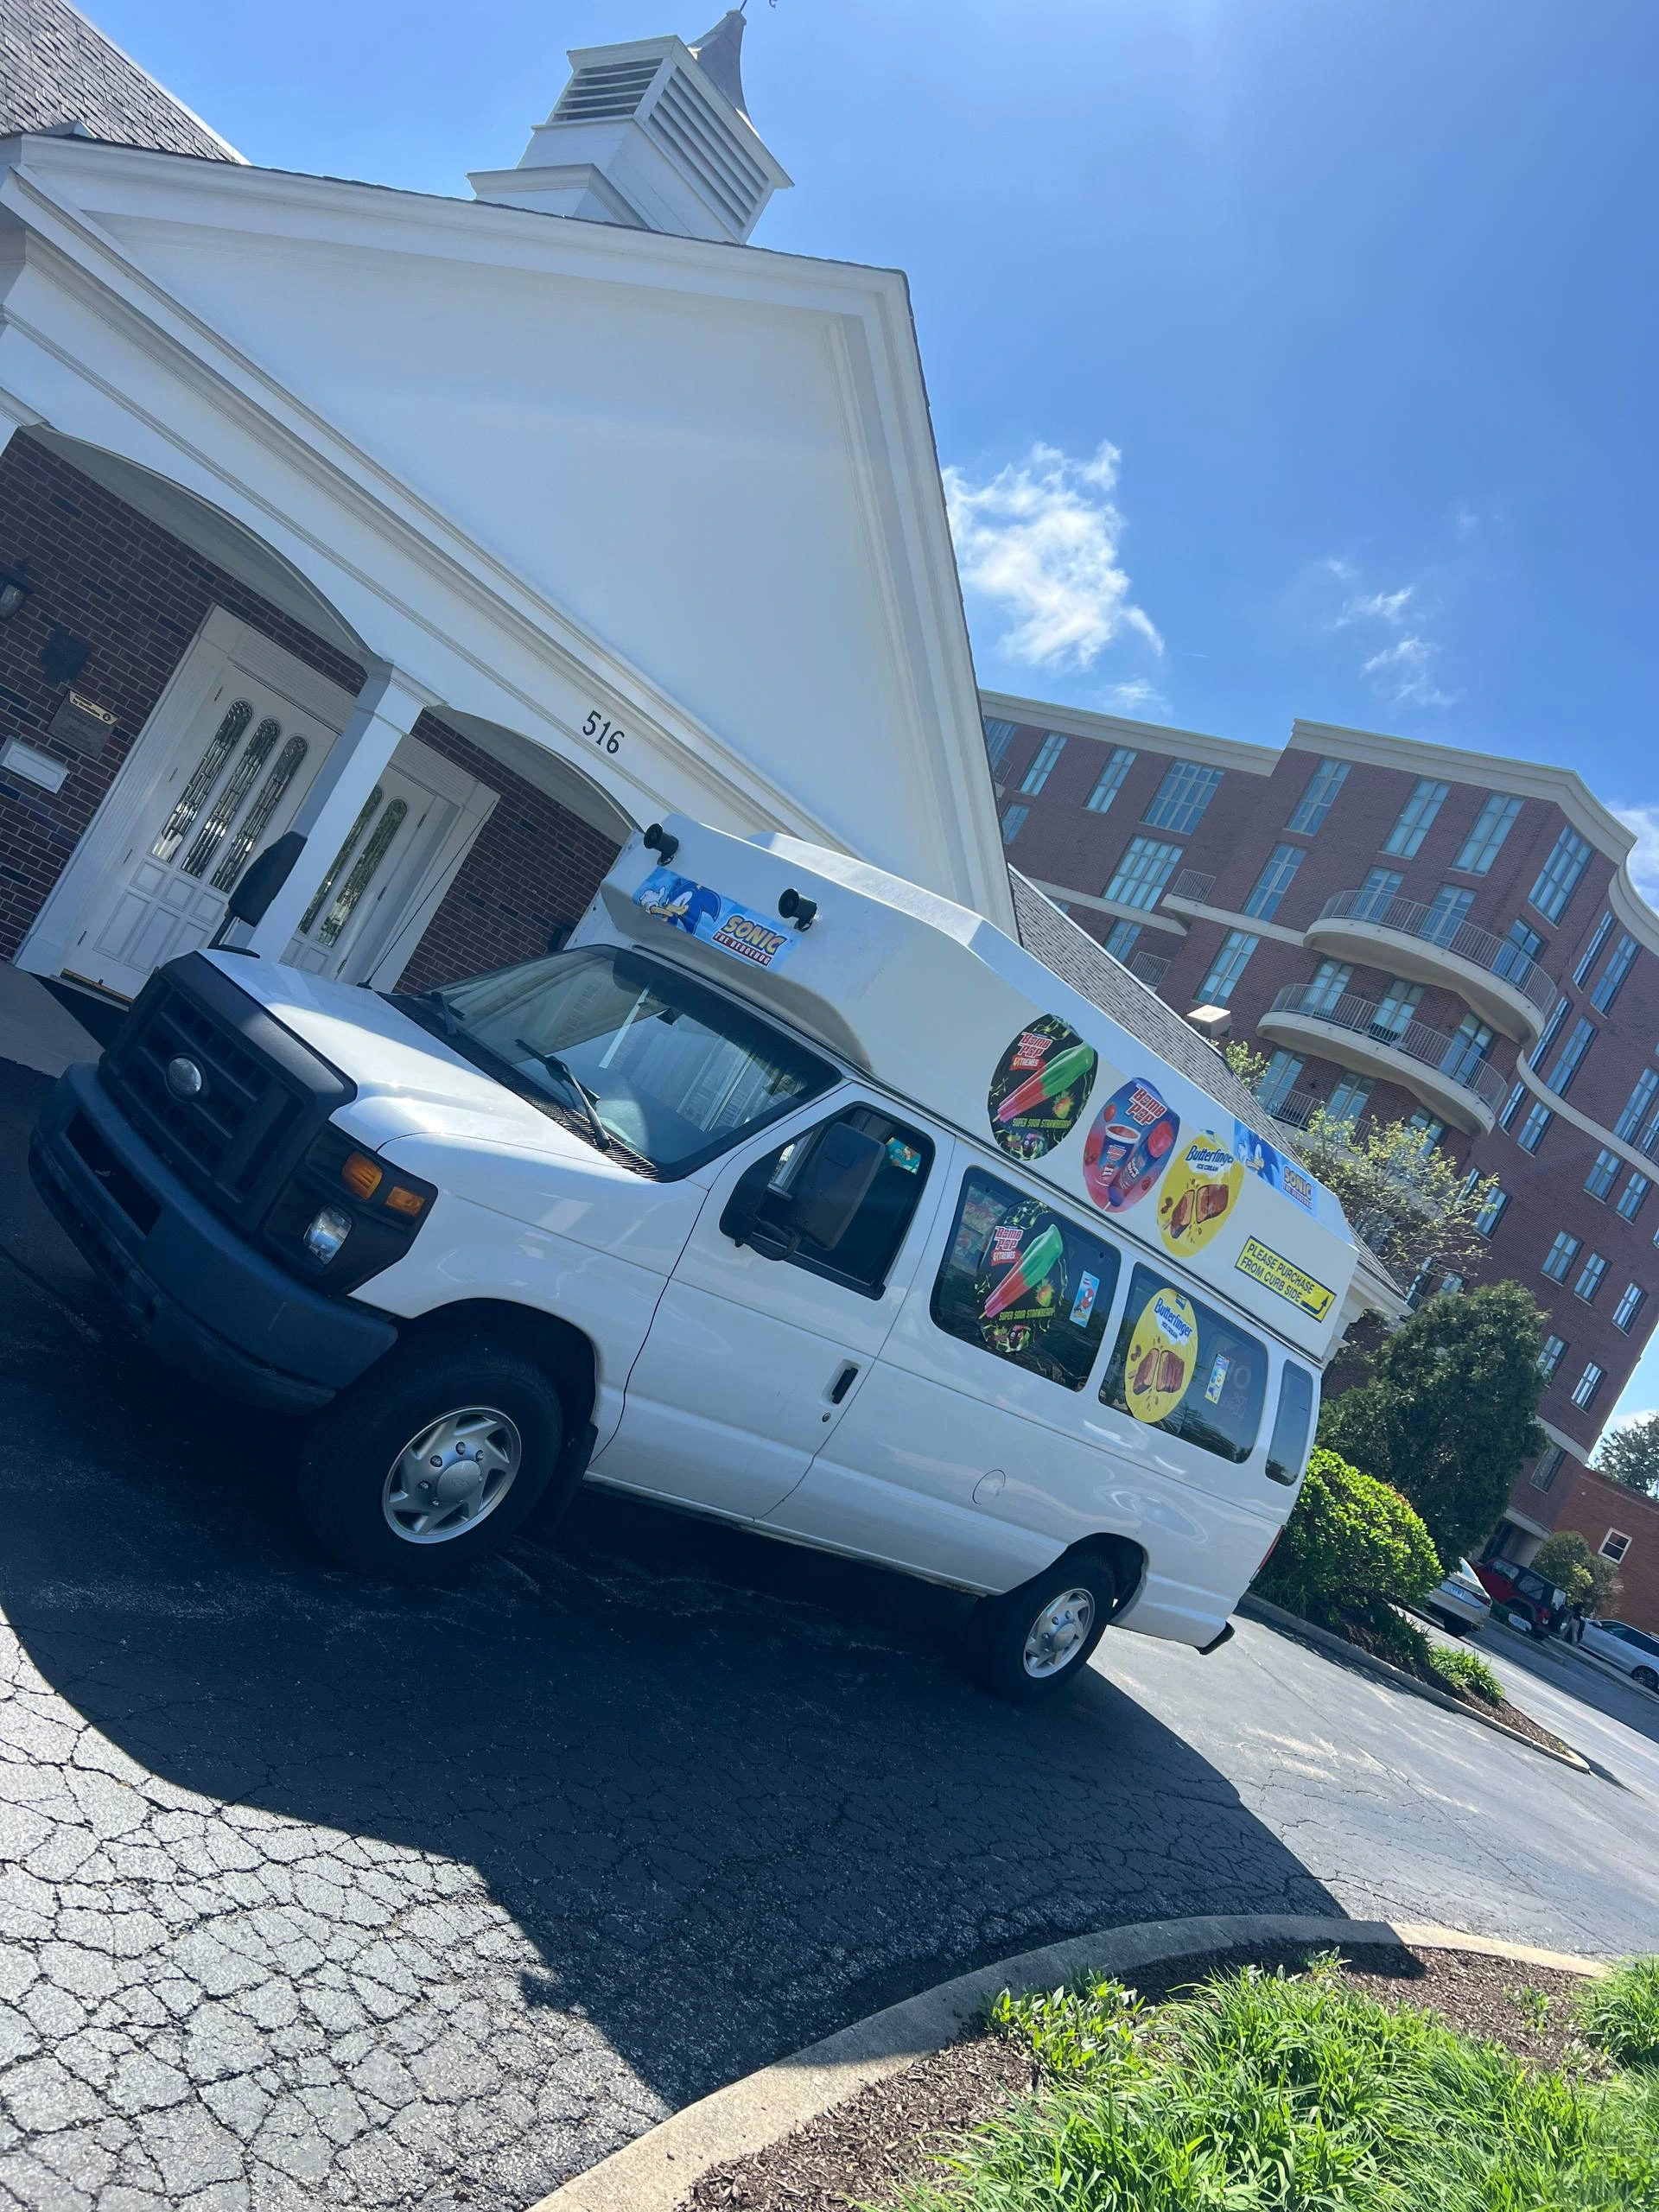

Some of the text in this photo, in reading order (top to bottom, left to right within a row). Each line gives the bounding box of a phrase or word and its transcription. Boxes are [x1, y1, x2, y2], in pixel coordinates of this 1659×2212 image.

[582, 709, 625, 753] 516
[714, 932, 772, 966] THE HEDGEHOG
[721, 915, 788, 954] SONIC
[1284, 1166, 1313, 1201] SONIC
[1240, 1256, 1303, 1303] FROM CURB SIDE
[1247, 1243, 1315, 1294] PLEASE PURCHASE
[1154, 1297, 1192, 1338] Butterfinger
